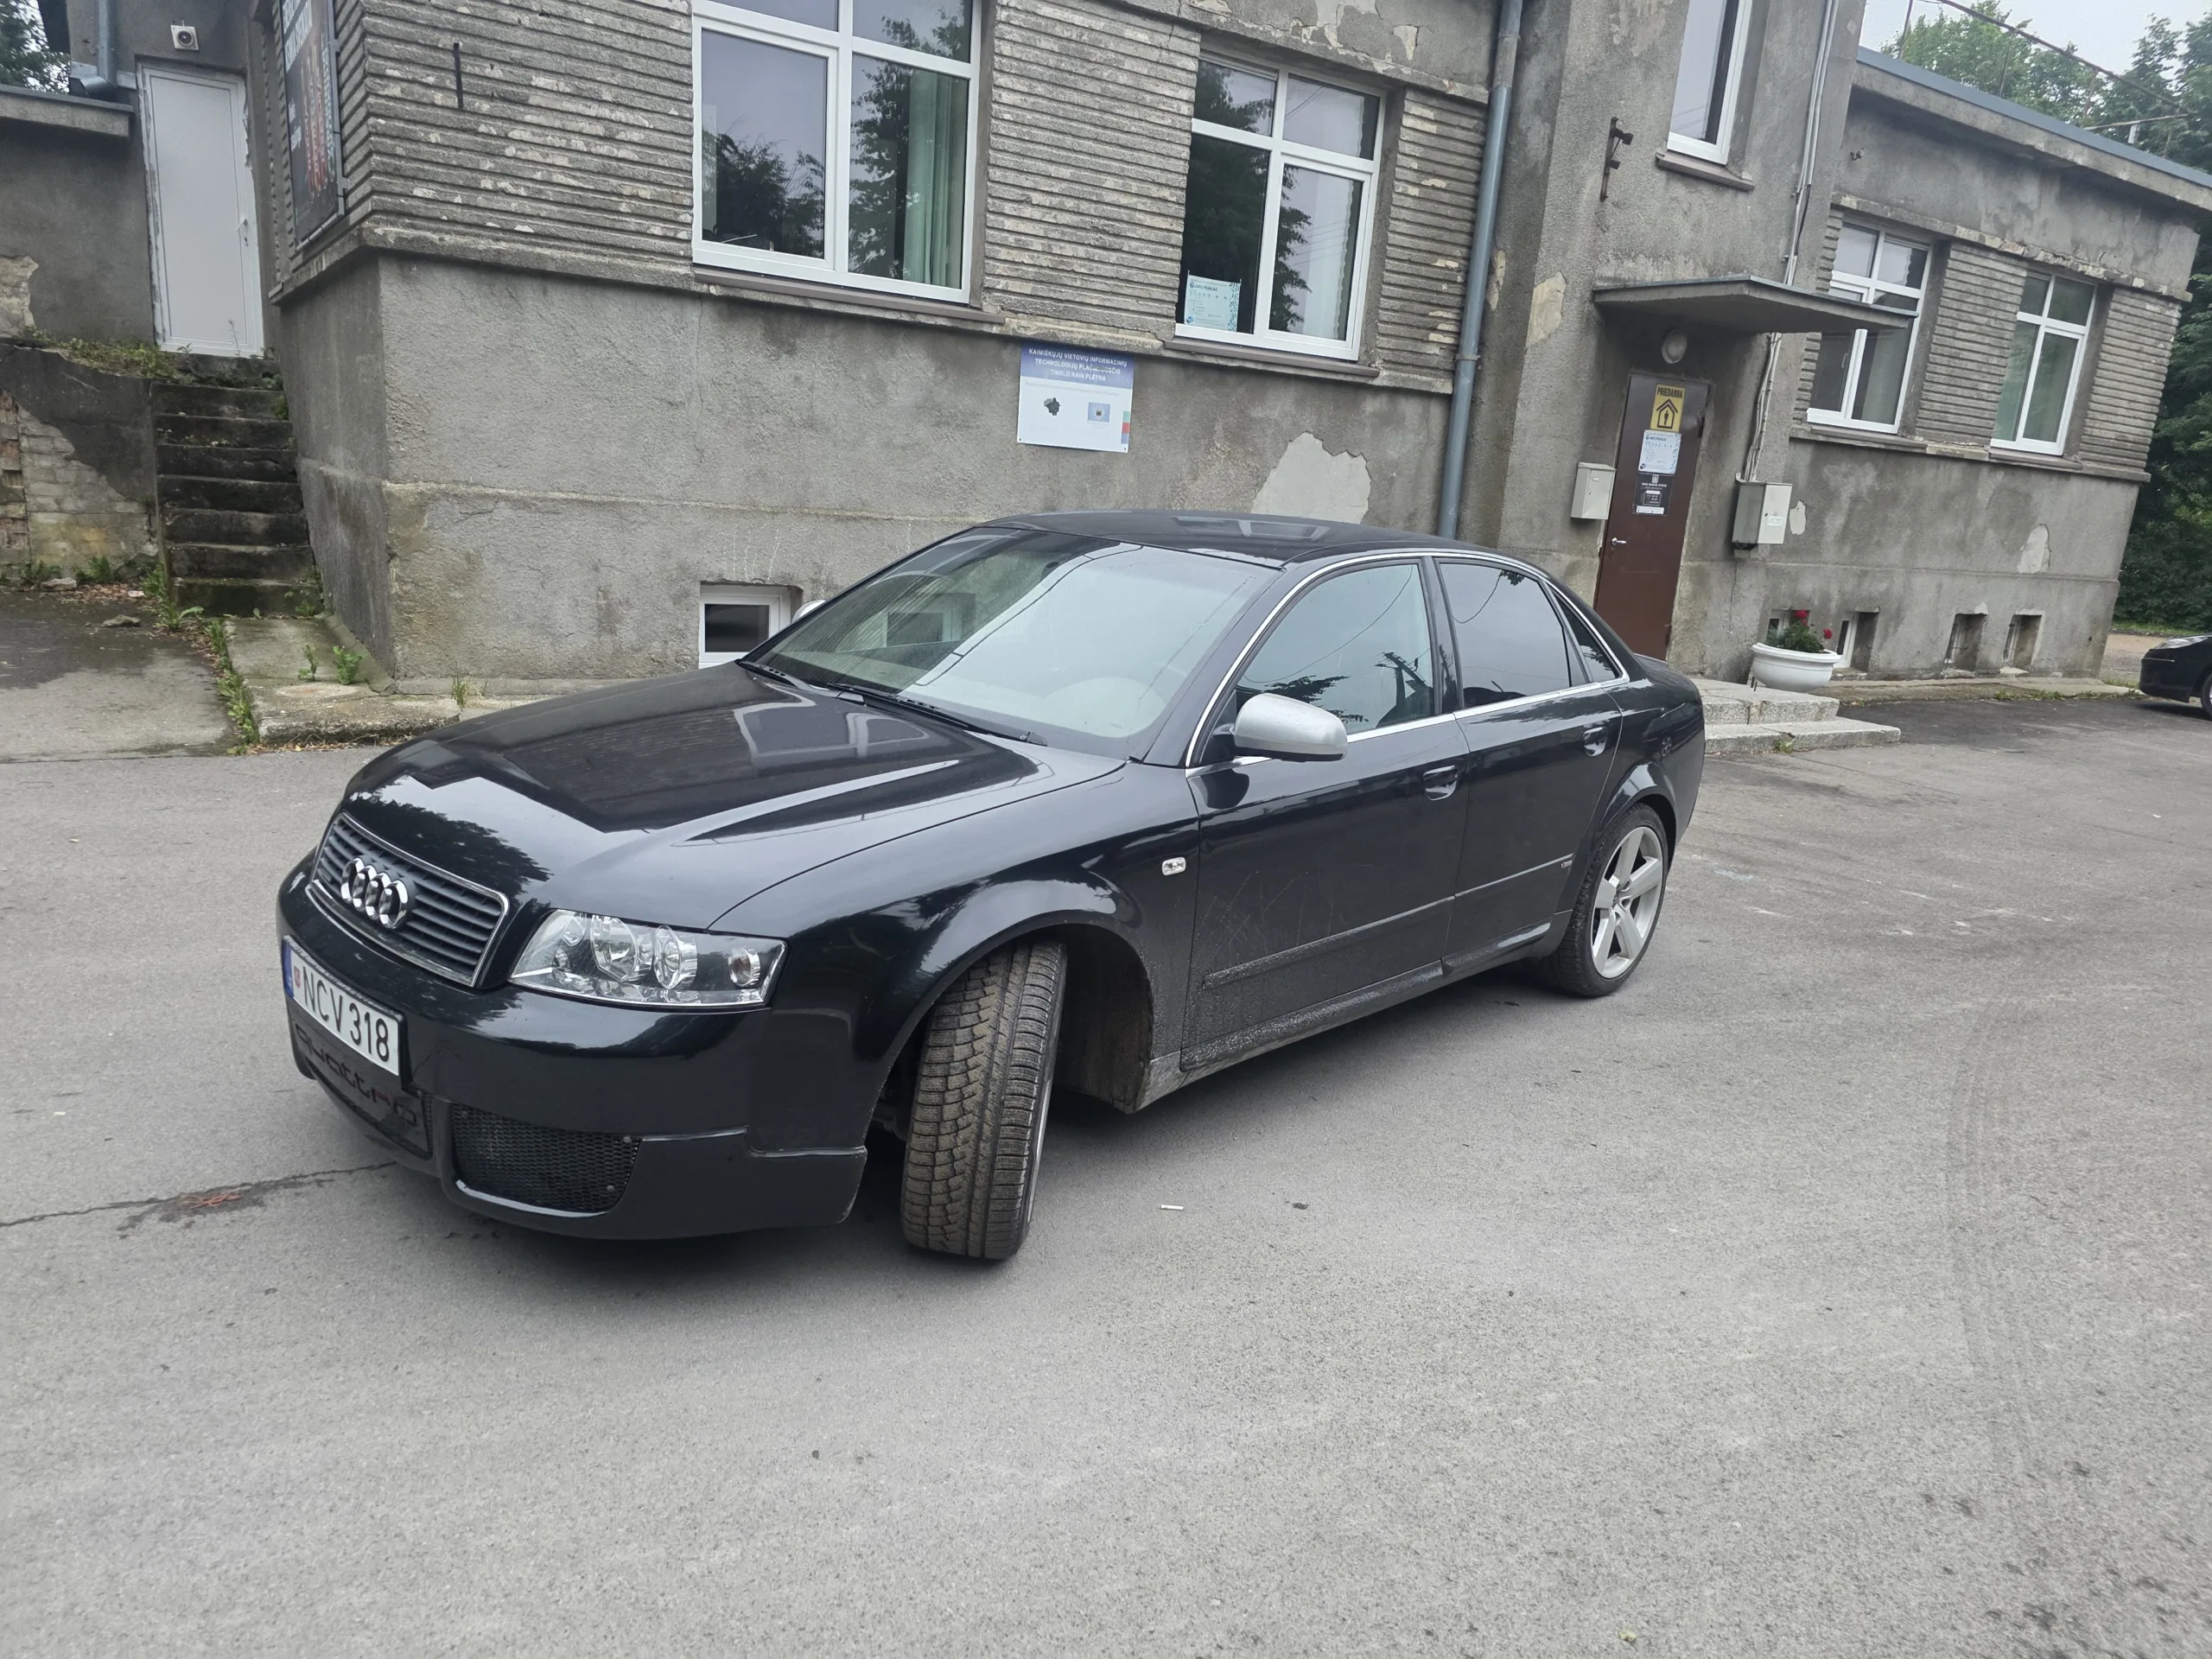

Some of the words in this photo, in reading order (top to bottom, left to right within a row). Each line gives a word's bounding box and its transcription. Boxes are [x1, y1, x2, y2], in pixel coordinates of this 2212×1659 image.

[1028, 348, 1063, 359] KAIMIŠKŲJŲ
[1064, 353, 1089, 363] VIETOVIŲ
[1090, 356, 1128, 367] INFORMACINIŲ
[1035, 358, 1078, 371] TECHNOLOGIJŲ
[1084, 372, 1106, 381] PLĖTRA
[302, 965, 344, 1033] NCV
[348, 1002, 390, 1063] 318
